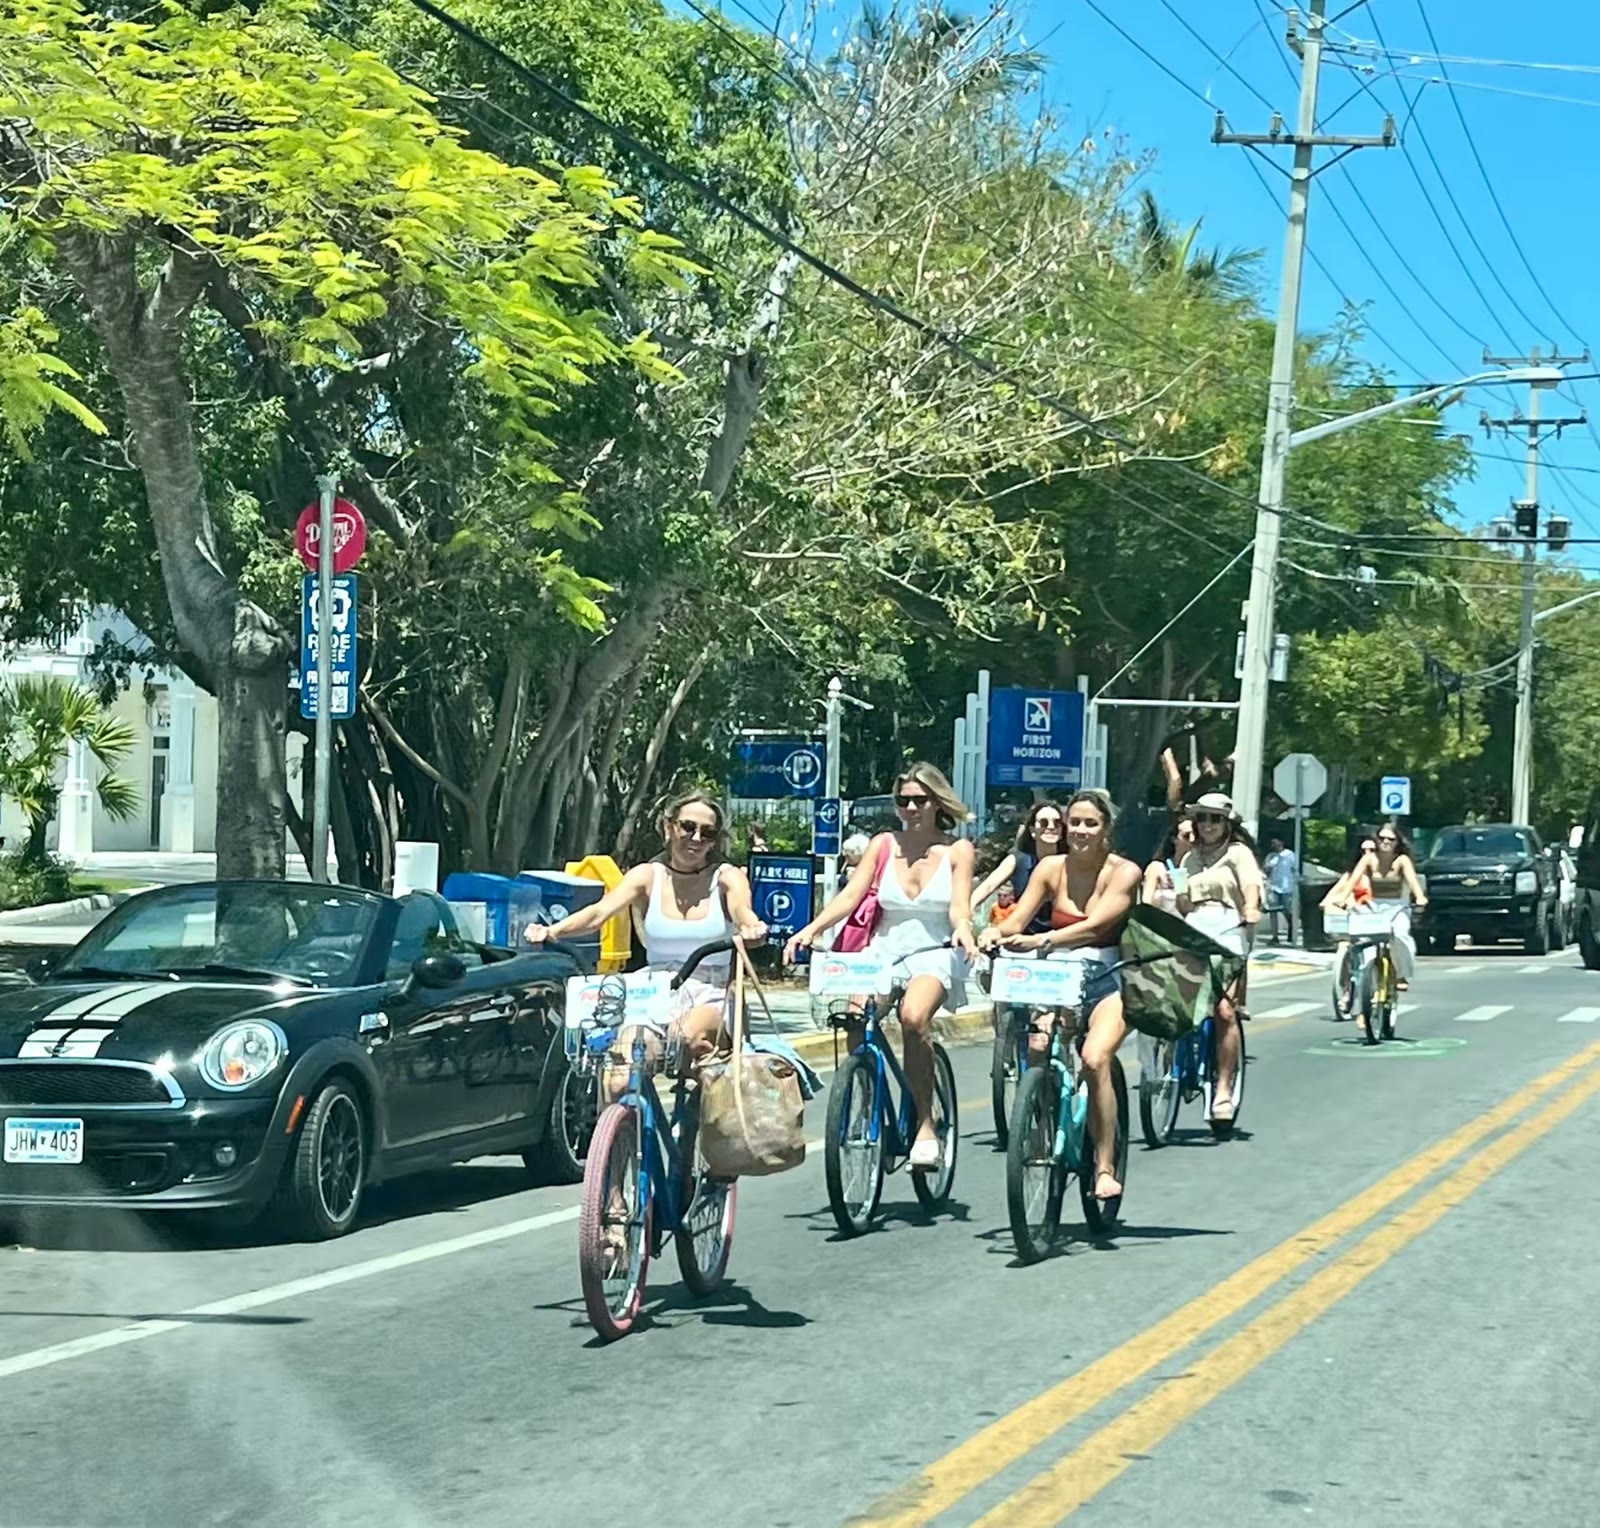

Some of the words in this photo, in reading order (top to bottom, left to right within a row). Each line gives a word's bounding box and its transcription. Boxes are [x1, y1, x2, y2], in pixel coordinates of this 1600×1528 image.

[308, 634, 351, 649] RDE
[311, 649, 346, 662] FEE
[1022, 734, 1052, 745] FIRST
[1012, 747, 1061, 759] HORIZON
[755, 866, 782, 878] PARK
[784, 868, 808, 880] HERE
[773, 894, 790, 917] P
[10, 1130, 38, 1151] JHW
[50, 1130, 78, 1152] 403
